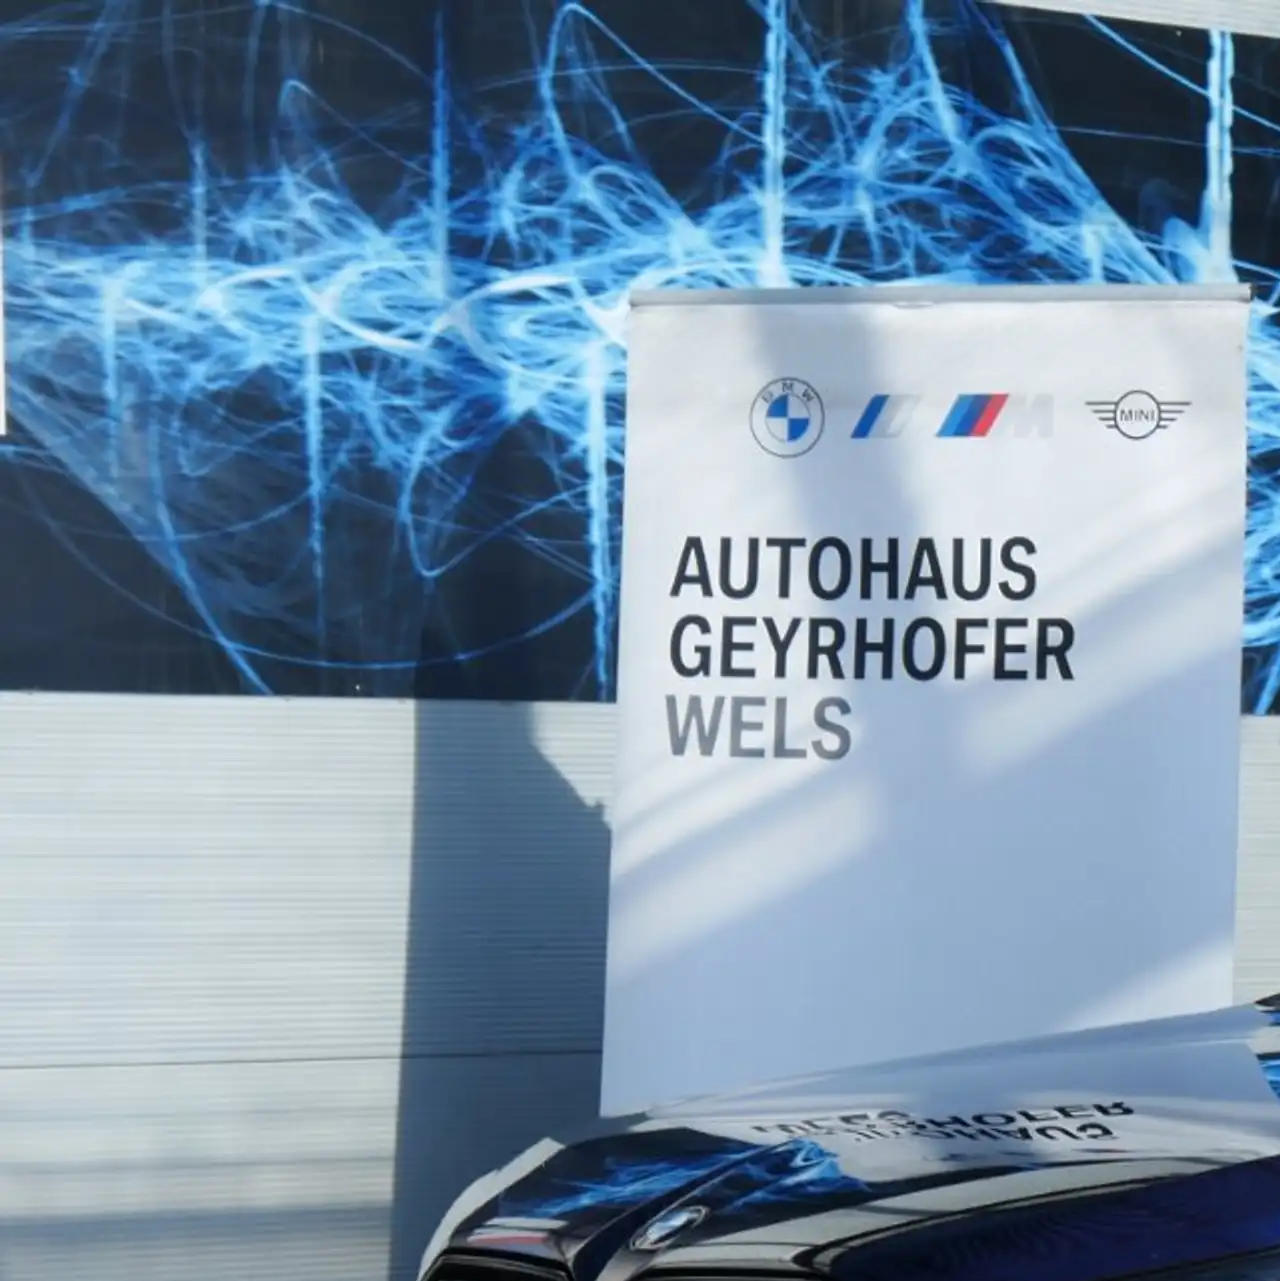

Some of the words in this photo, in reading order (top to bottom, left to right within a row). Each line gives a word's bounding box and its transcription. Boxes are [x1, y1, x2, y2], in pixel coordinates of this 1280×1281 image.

[762, 382, 815, 404] BMW
[1119, 408, 1156, 421] MINI
[669, 535, 1038, 601] AUTOHAUS
[669, 613, 1076, 682] GEYRHOFER
[665, 693, 853, 760] WELS
